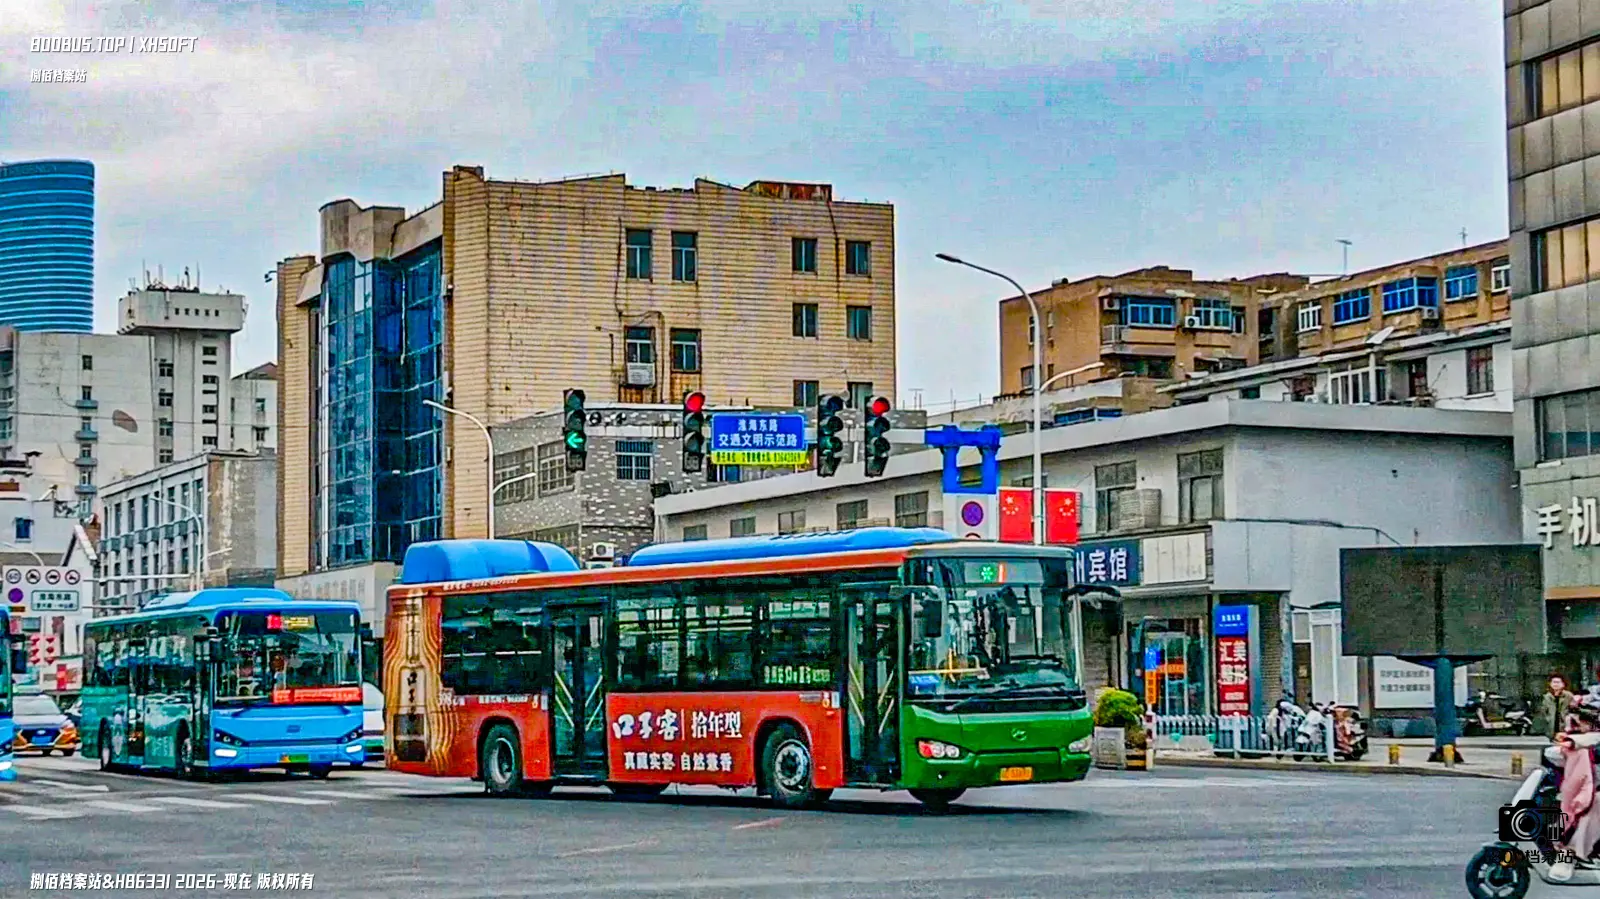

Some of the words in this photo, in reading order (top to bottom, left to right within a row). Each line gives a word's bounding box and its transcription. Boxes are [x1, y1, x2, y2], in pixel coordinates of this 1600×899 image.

[718, 433, 798, 447] 交通文明示范路
[1535, 496, 1600, 549] 手机
